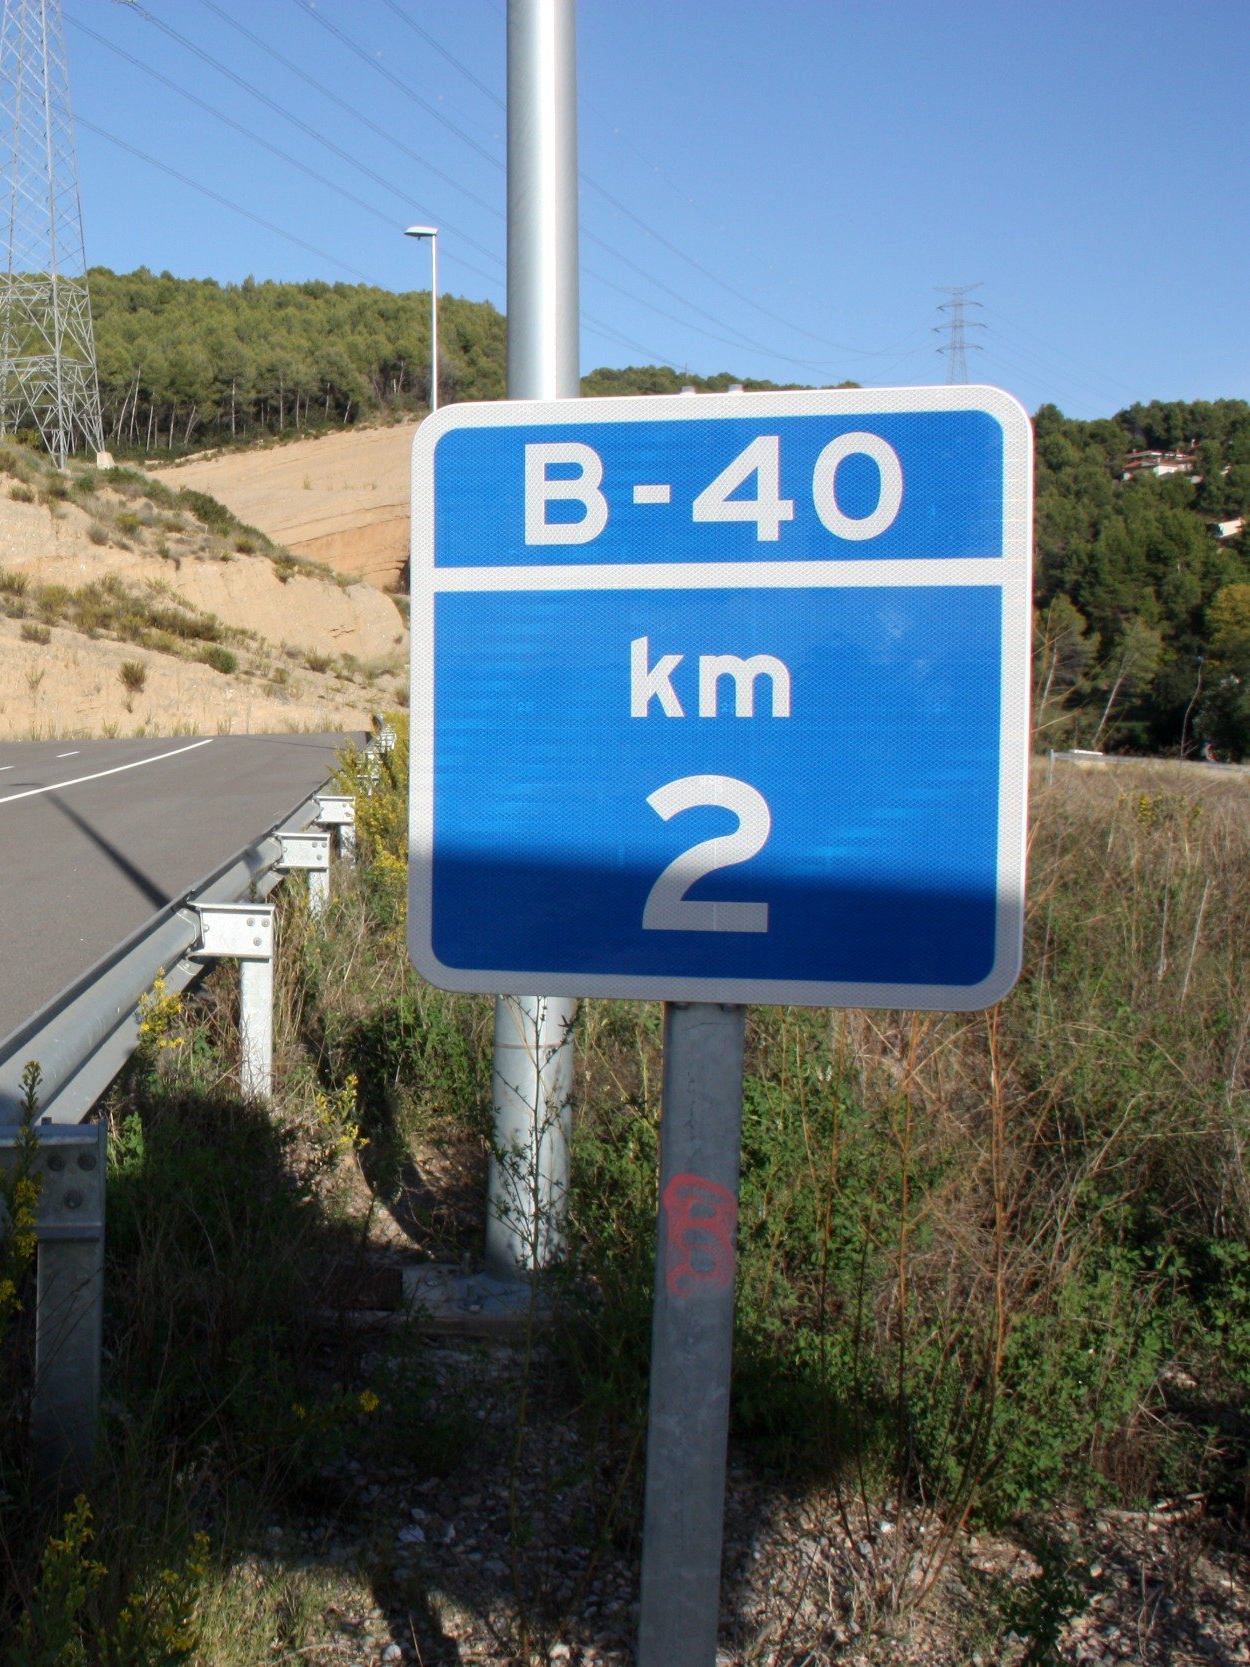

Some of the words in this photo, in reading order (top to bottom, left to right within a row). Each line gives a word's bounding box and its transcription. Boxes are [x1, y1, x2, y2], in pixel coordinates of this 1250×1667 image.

[525, 431, 903, 546] B-40
[631, 636, 792, 718] km
[642, 774, 771, 933] 2
